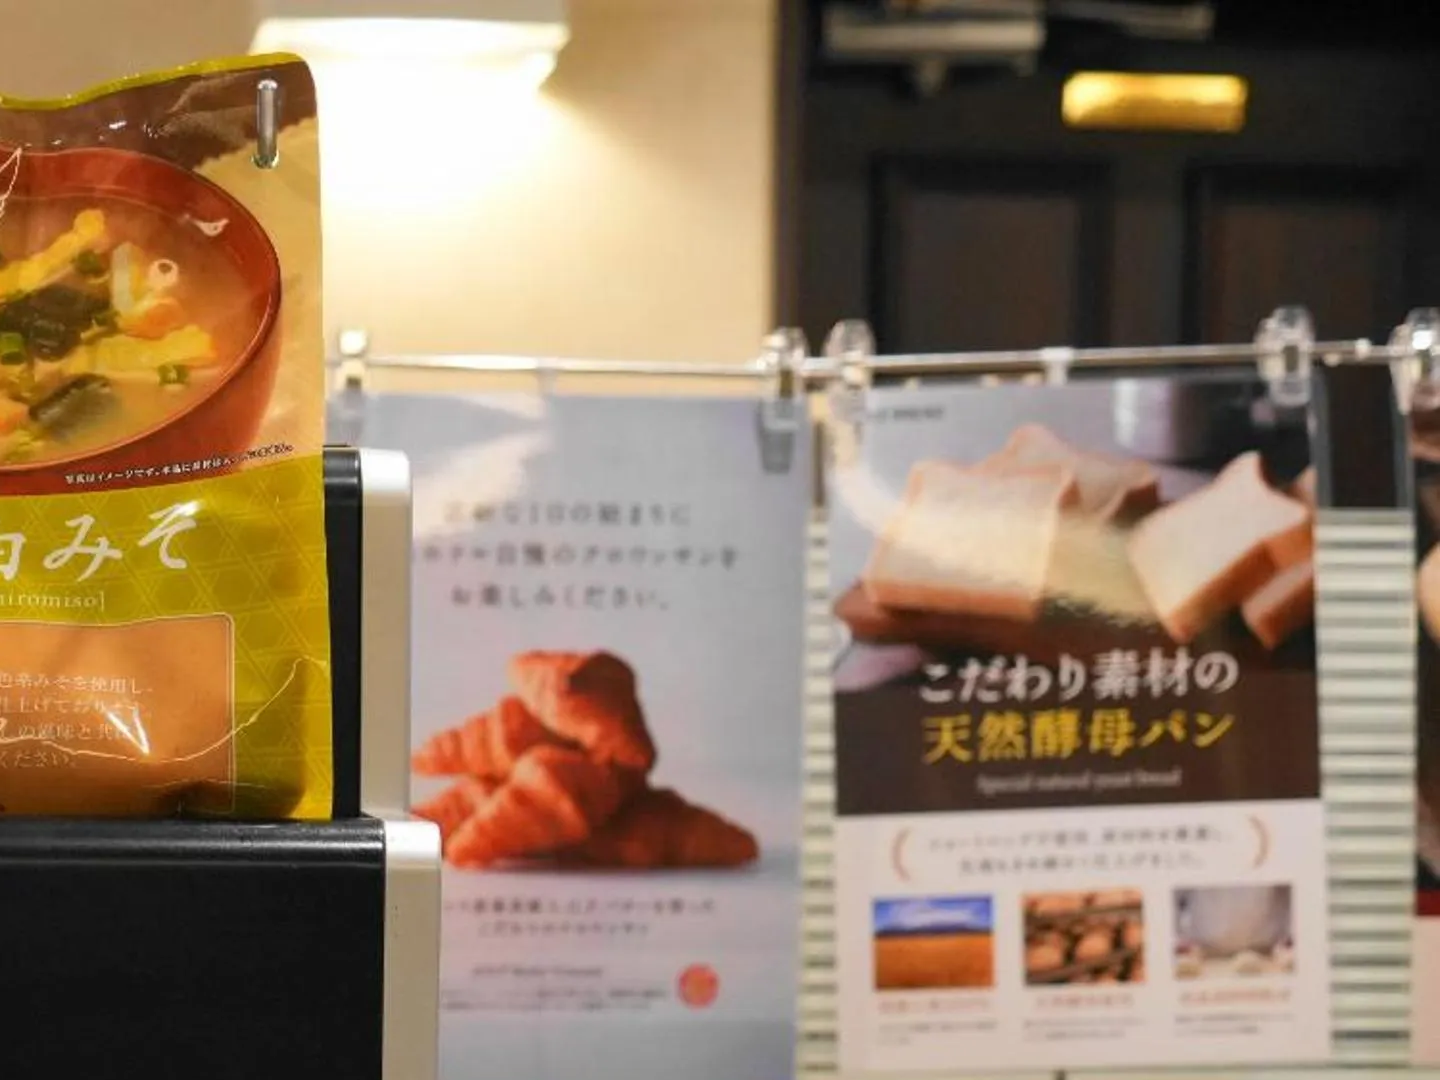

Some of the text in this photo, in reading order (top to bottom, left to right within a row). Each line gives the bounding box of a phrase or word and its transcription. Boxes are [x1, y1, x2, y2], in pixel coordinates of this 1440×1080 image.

[918, 646, 1239, 703] こだわり素材の
[921, 707, 1235, 764] 天然酵母パン
